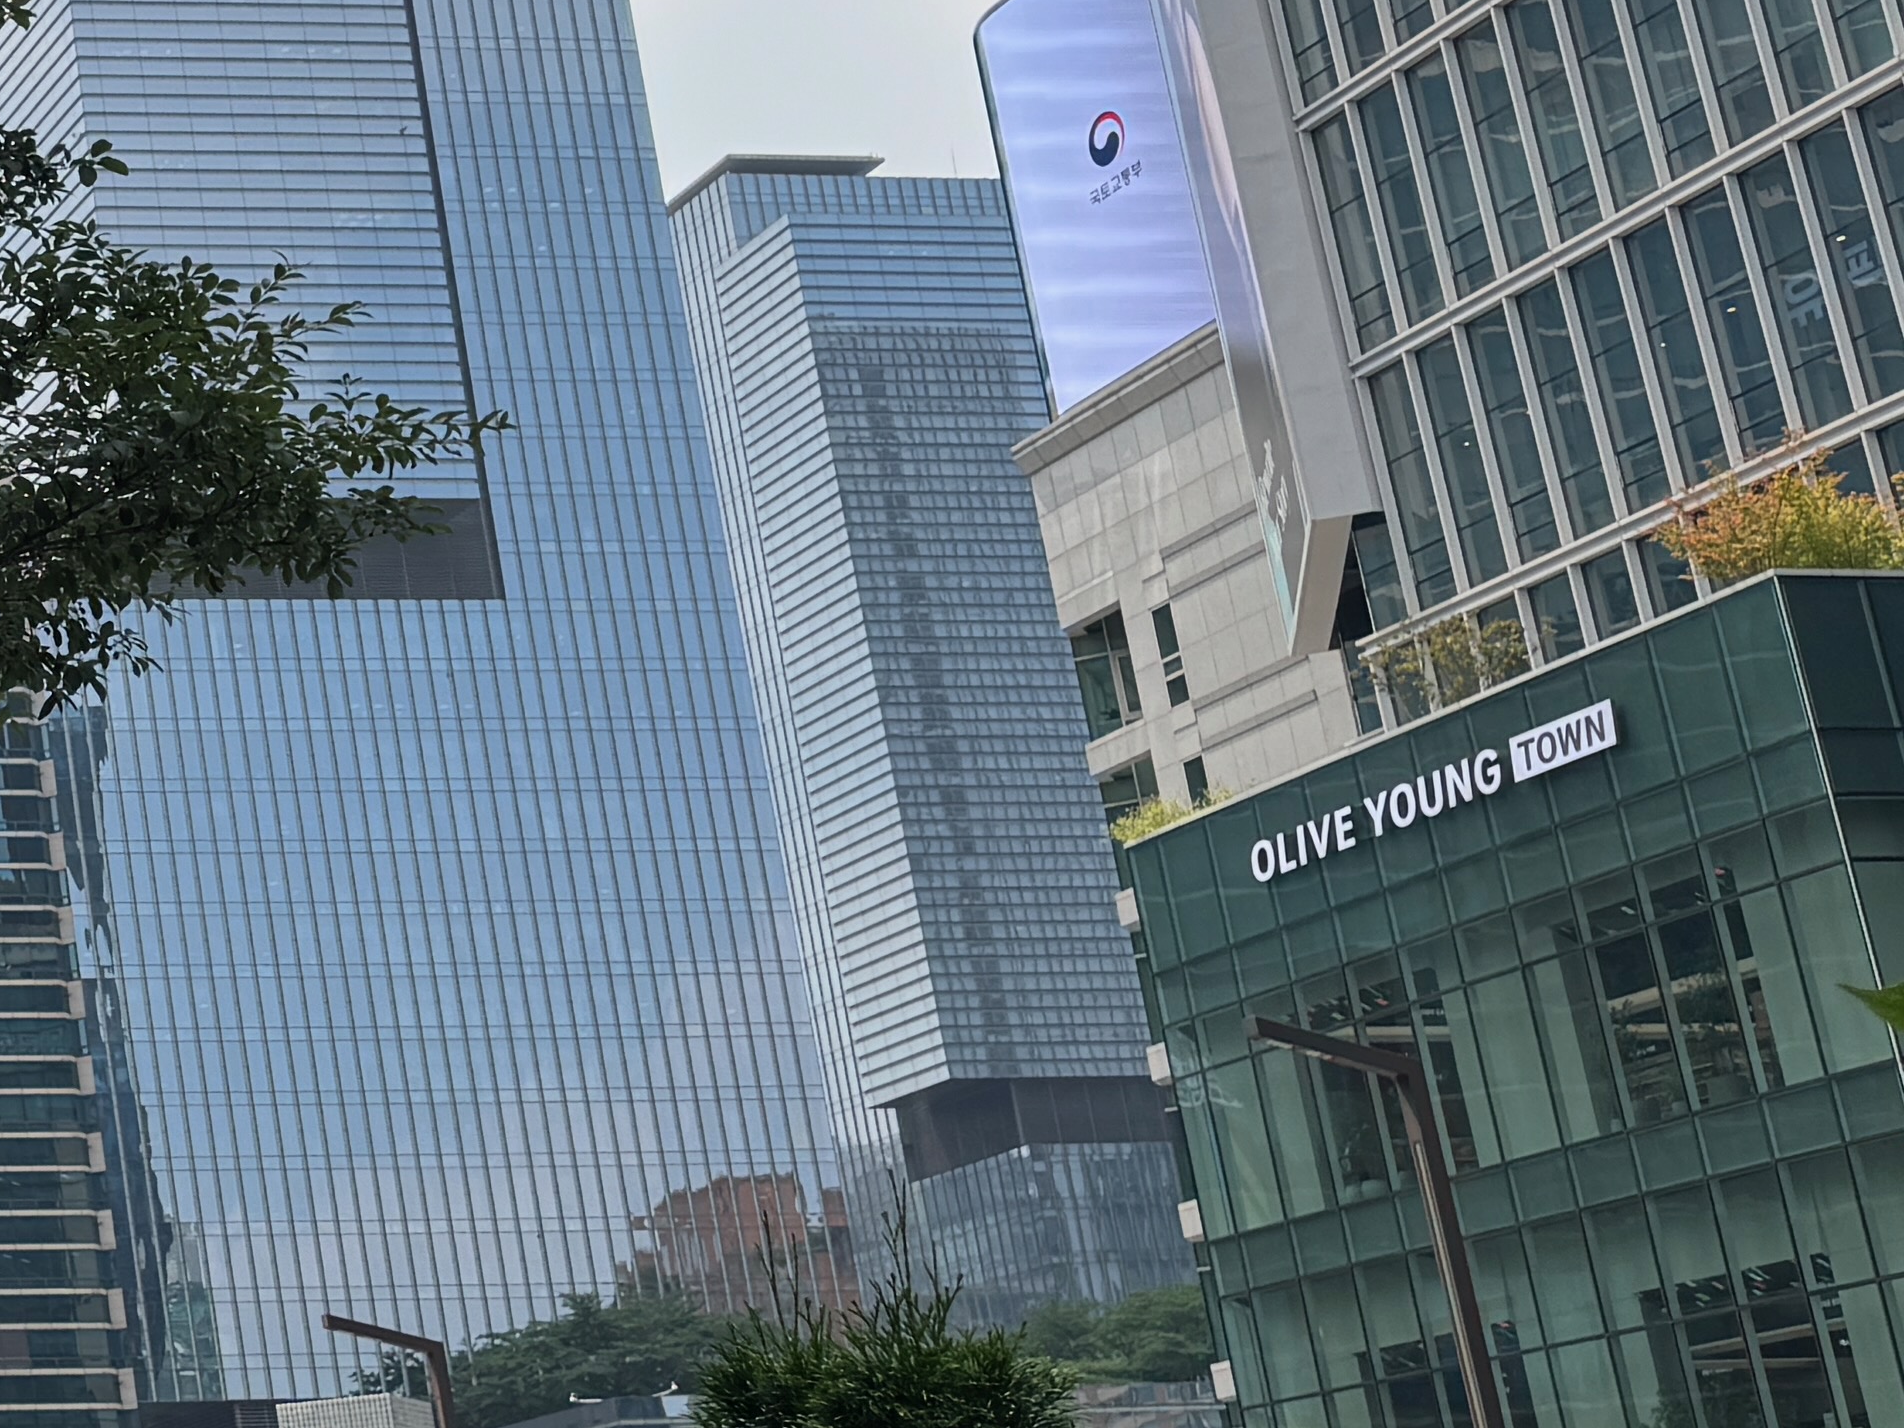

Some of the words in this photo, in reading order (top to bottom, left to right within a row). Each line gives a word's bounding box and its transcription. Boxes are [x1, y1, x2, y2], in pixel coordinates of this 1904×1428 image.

[1089, 159, 1143, 205] 국토교통부
[1250, 806, 1358, 882] OLIVE
[1362, 747, 1504, 839] YOUNG
[1517, 709, 1608, 772] TOWN
